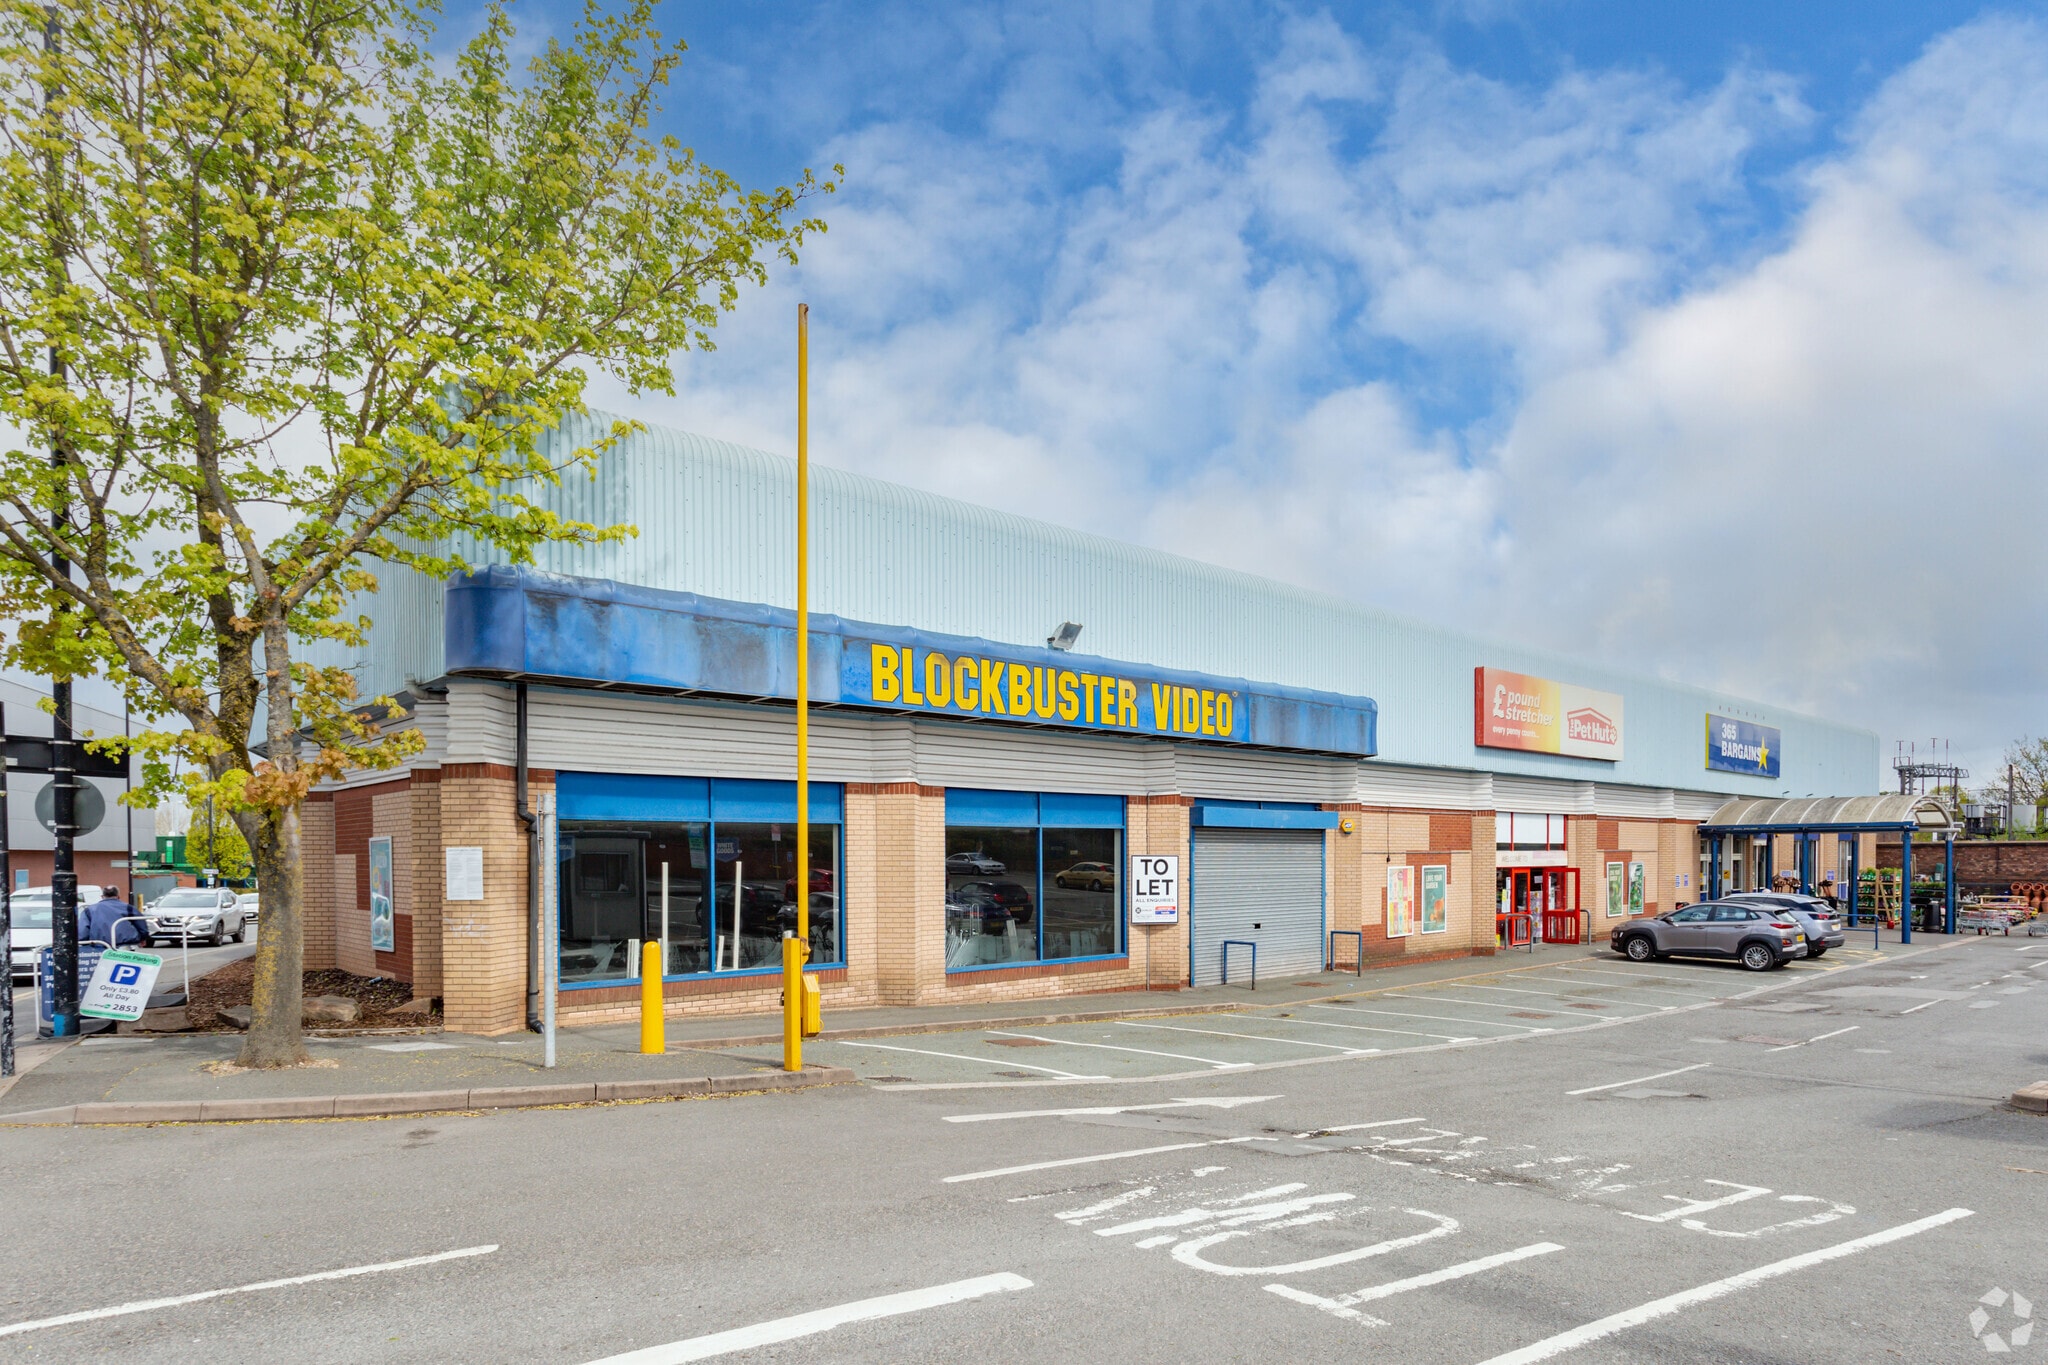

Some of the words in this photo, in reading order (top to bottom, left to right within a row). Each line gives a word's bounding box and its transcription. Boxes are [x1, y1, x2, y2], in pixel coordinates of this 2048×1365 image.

[871, 643, 1138, 728] BLOCKBUSTER
[1151, 682, 1233, 737] VIDEO
[1507, 692, 1541, 708] pound
[1506, 705, 1553, 726] stretcher
[1721, 723, 1736, 740] 365
[1721, 740, 1762, 762] BARGAINS
[1140, 859, 1168, 875] TO
[1136, 879, 1173, 895] LET
[107, 951, 131, 960] Station
[132, 955, 158, 964] Parking
[114, 966, 136, 982] P
[100, 985, 117, 993] Only
[115, 993, 130, 1001] Day
[112, 1004, 138, 1012] 2853
